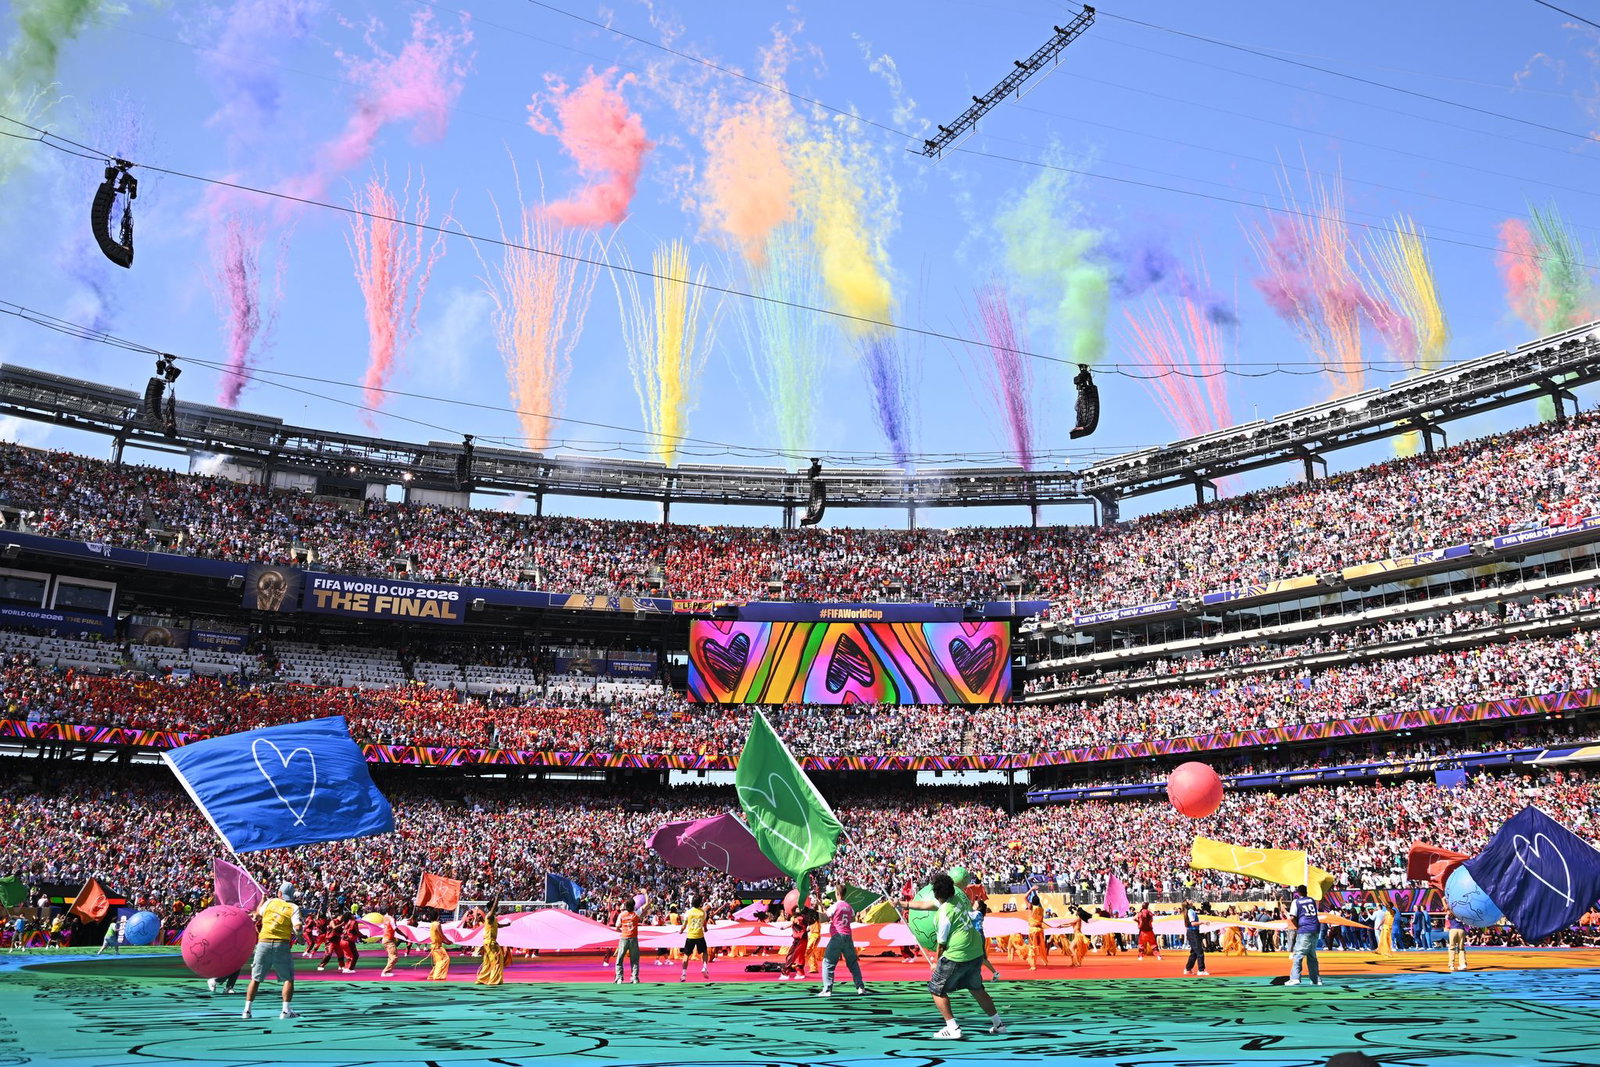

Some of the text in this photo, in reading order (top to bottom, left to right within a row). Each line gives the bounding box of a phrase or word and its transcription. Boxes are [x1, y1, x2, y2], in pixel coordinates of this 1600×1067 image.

[1502, 536, 1518, 545] FIFA
[1518, 531, 1542, 542] WORLD
[314, 578, 460, 601] FIFA WORLD CUP 2026
[312, 590, 457, 620] THE FINAL
[2, 608, 26, 616] WORLD
[82, 618, 104, 626] FINAL
[820, 608, 883, 620] #FIFAWorldCup
[1079, 616, 1096, 624] NEW
[1120, 608, 1138, 617] NEW
[1139, 603, 1172, 614] JERSEY
[1002, 903, 1017, 912] FIFA
[1302, 904, 1316, 916] 19
